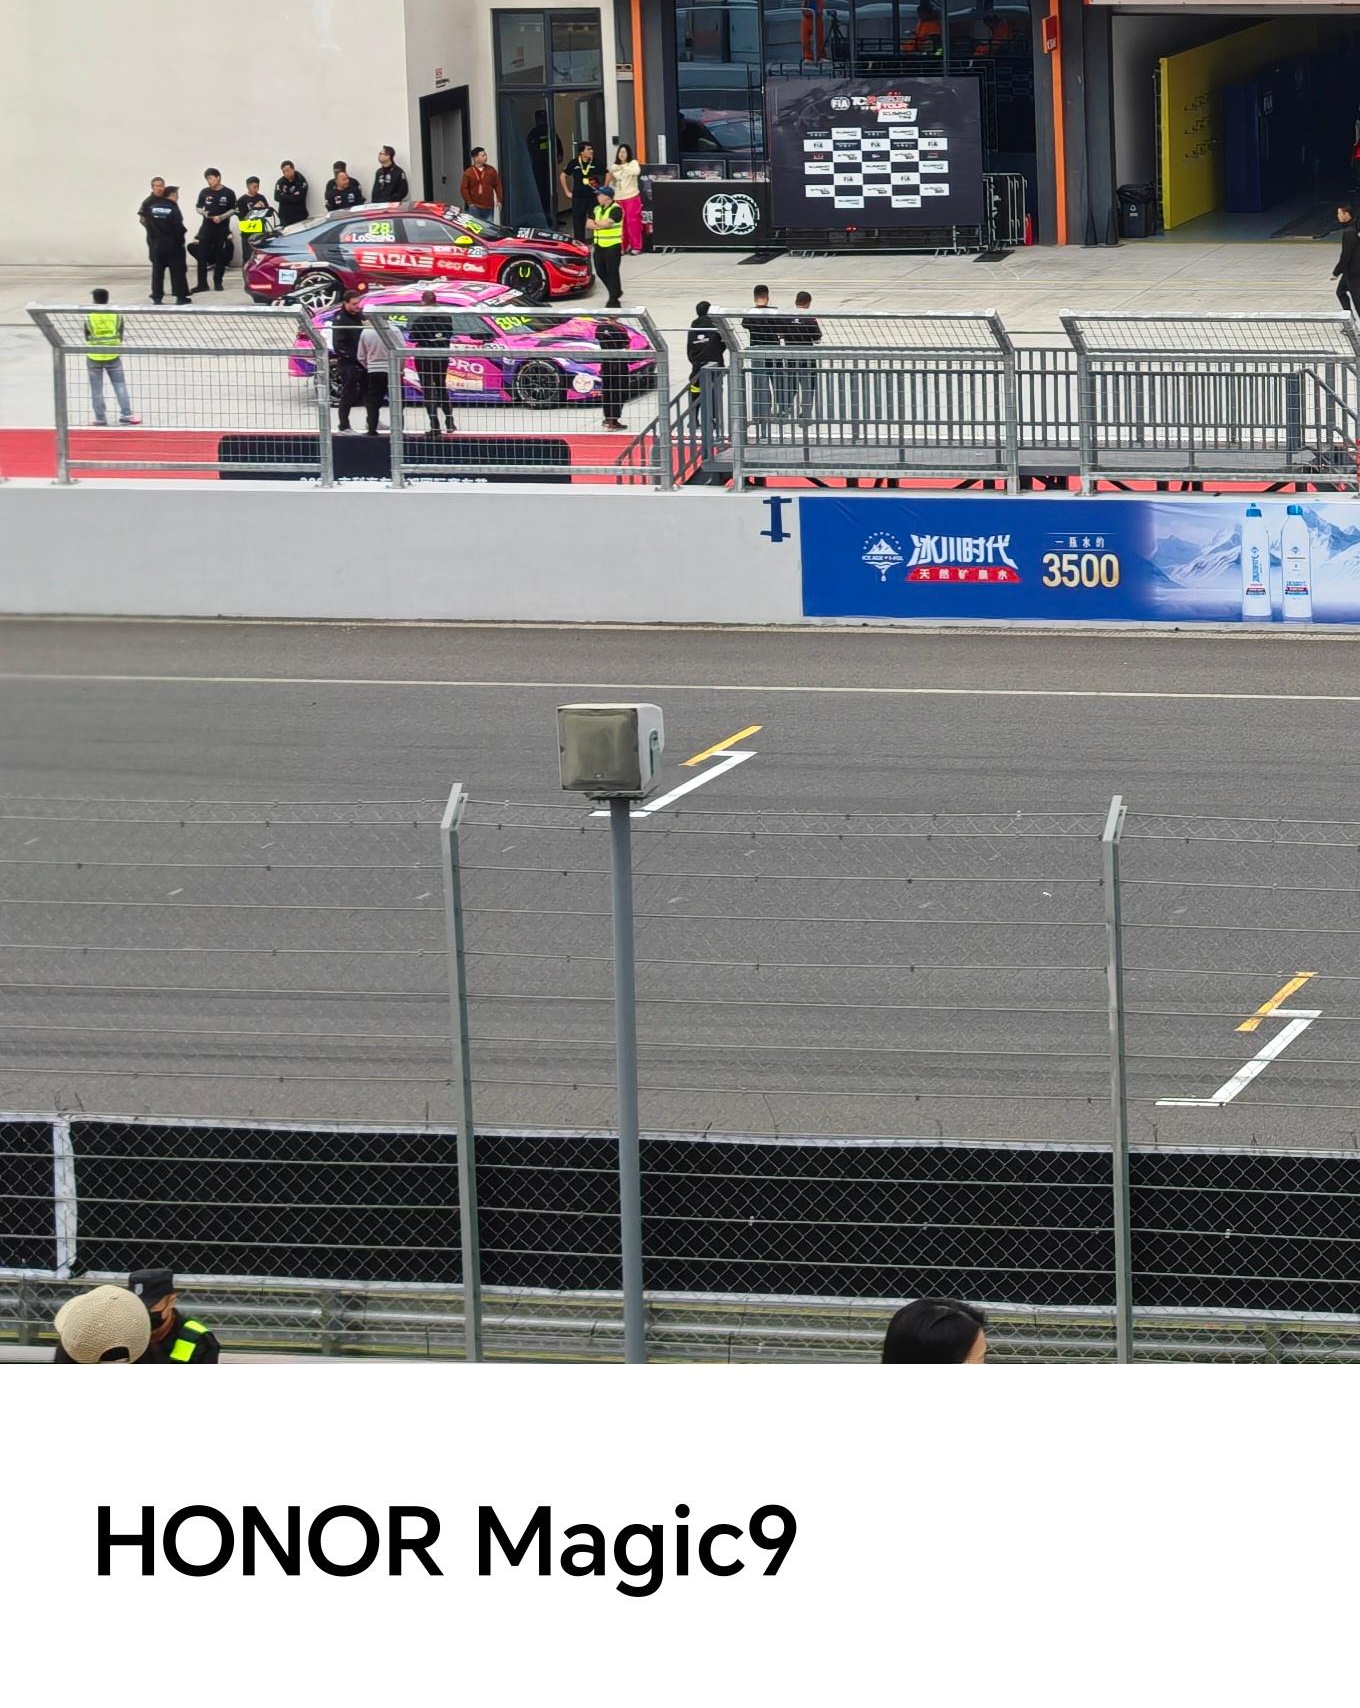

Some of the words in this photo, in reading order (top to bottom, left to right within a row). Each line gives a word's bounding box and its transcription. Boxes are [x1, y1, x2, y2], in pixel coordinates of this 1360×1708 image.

[371, 222, 391, 235] 28
[906, 533, 1019, 570] 冰川时代
[919, 567, 1008, 581] 天然矿泉水
[1042, 553, 1119, 588] 3500
